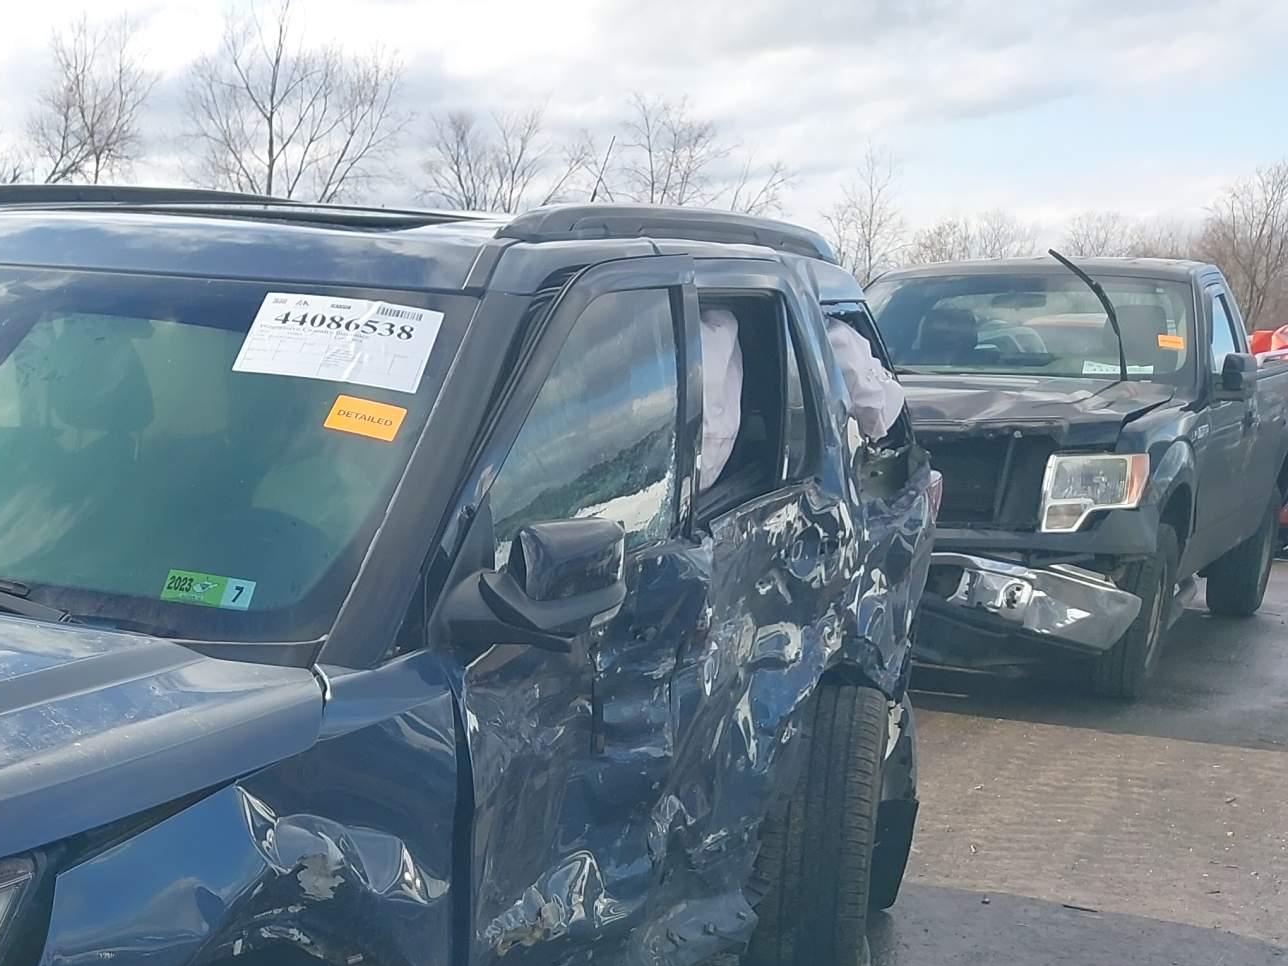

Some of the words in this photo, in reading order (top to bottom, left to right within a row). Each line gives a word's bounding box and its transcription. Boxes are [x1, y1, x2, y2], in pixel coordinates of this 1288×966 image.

[274, 310, 415, 341] 44086538
[336, 408, 393, 427] DETAILED
[166, 575, 194, 592] 2023
[231, 585, 244, 603] 7
